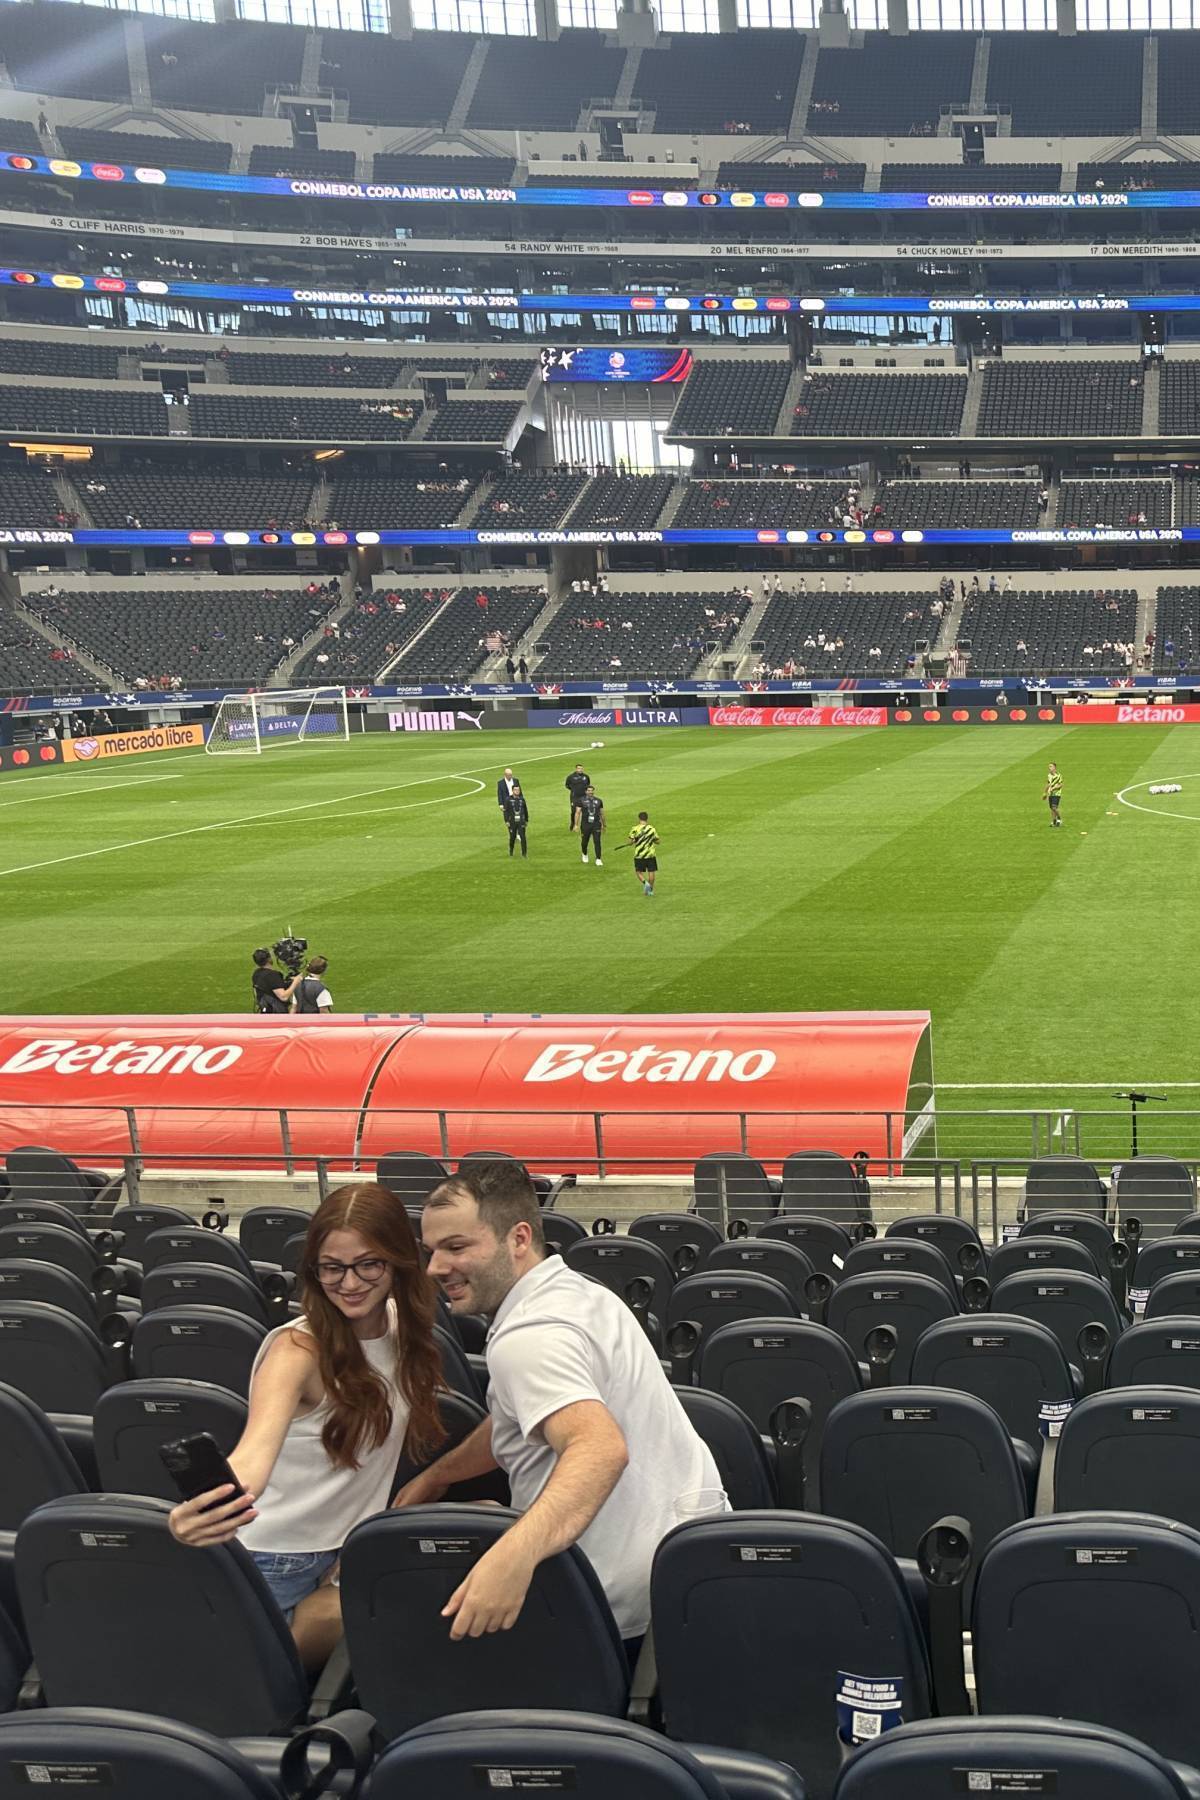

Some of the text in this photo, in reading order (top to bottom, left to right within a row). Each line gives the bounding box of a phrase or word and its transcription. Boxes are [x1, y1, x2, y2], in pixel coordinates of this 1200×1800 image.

[290, 181, 517, 201] CONMEBOL COPA AMERICA USA 2024
[927, 194, 1128, 206] CONMEBOL COPA AMERICA USA 2024
[50, 218, 63, 227] 43
[69, 219, 100, 231] CLIFF
[104, 221, 146, 234] HARRIS
[299, 235, 311, 245] 22
[316, 236, 338, 246] BOB
[340, 237, 372, 248] HAYES
[504, 243, 516, 252] 54
[520, 243, 551, 252] RANDY
[555, 244, 584, 253] WHITE
[710, 246, 722, 255] 20
[726, 246, 743, 255] MEL
[746, 246, 778, 255] RENFRO
[897, 247, 908, 256] 54
[911, 247, 938, 256] CHUCK
[940, 247, 973, 256] HOWLEY
[1090, 247, 1098, 255] 17
[1102, 246, 1120, 255] DON
[1122, 246, 1163, 255] MEREDITH
[292, 290, 518, 307] CONMEBOL COPA AMERICA USA 2024
[928, 299, 1128, 311] CONMEBOL COPA AMERICA USA 2024
[16, 532, 42, 543] USA
[43, 532, 73, 543] 2024
[477, 532, 663, 543] CONMEBOL COPA AMERICA USA 2024
[1011, 529, 1182, 541] CONMEBOL COPA AMERICA USA 2024
[558, 711, 679, 726] Michelob ULTRA
[713, 707, 881, 726] Coca-Cola Coca-Cola Coca-Cola
[1117, 705, 1185, 723] Betano
[274, 720, 298, 730] DELTA
[388, 711, 456, 732] PUMA
[104, 729, 194, 754] mercado libre
[0, 1039, 244, 1076] Betano
[523, 1044, 778, 1083] Betano
